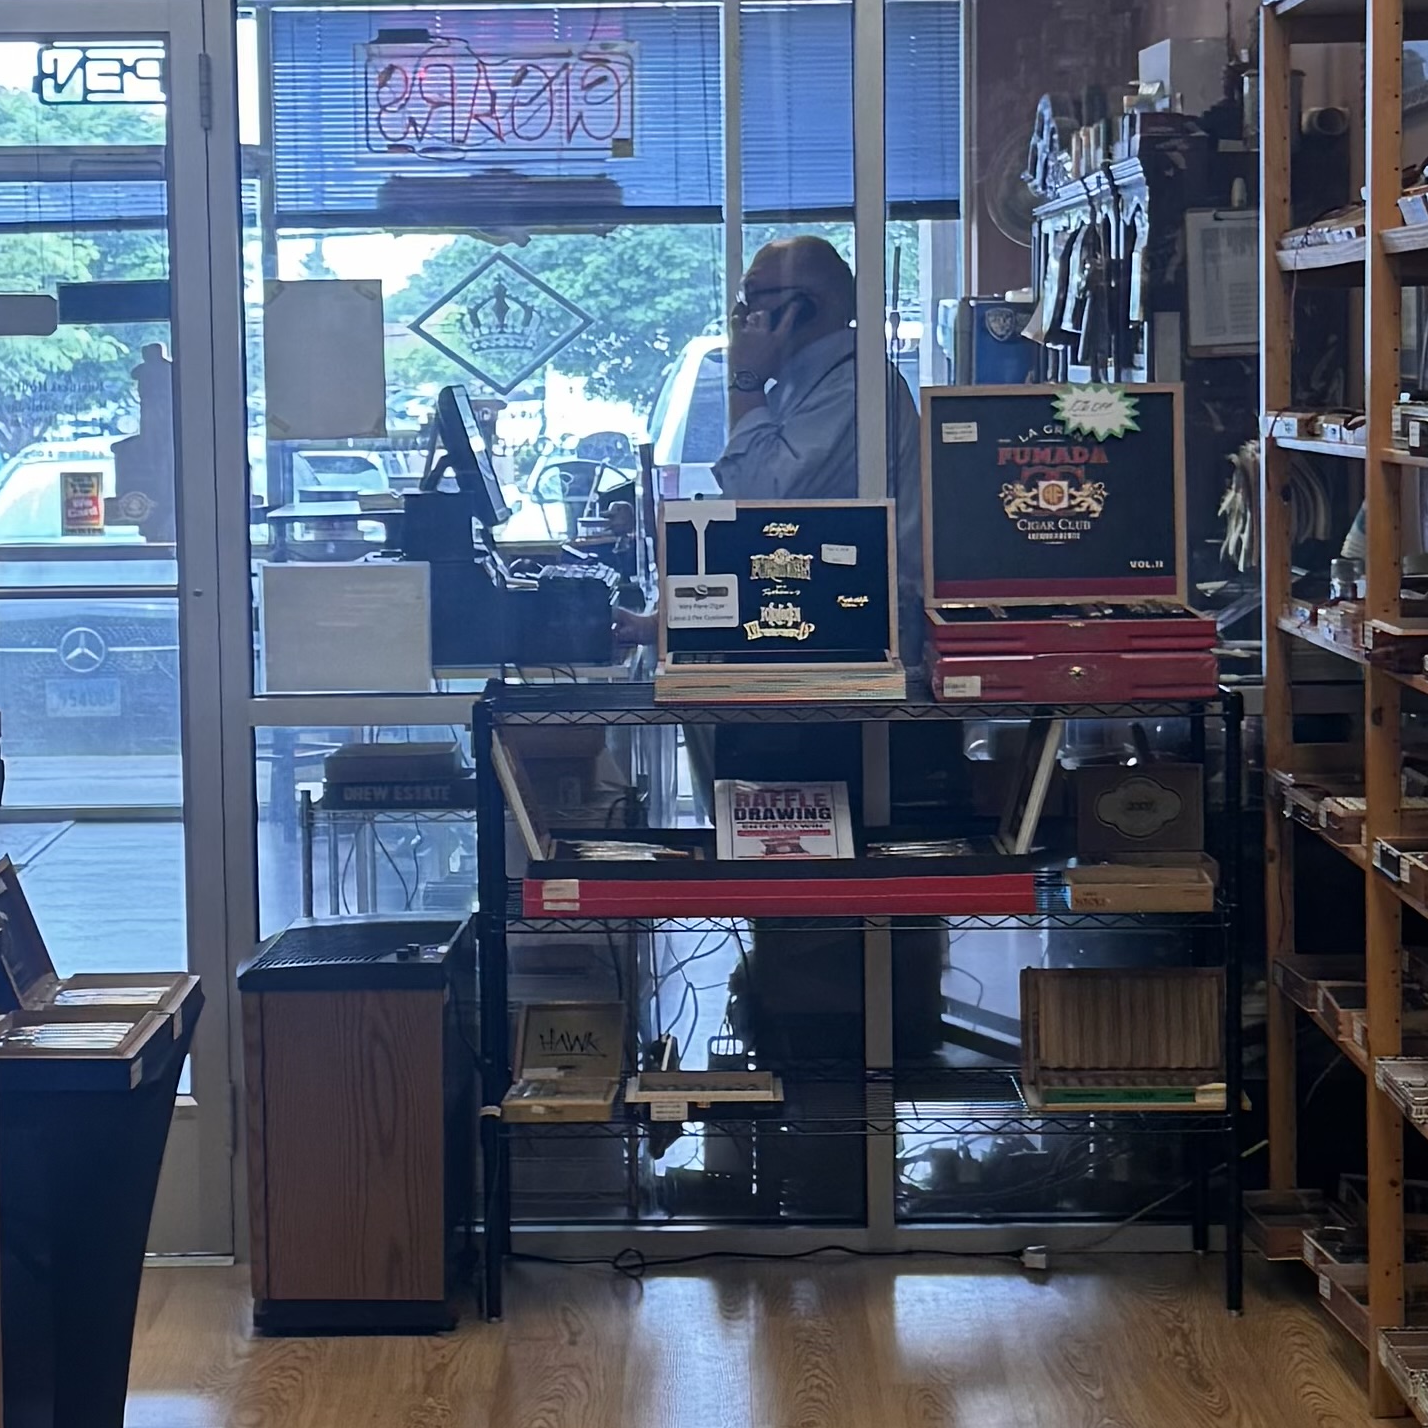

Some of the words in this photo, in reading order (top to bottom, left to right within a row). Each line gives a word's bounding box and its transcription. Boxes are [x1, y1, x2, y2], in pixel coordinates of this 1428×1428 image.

[996, 447, 1109, 466] FUMADA
[735, 793, 827, 807] RAFFLE
[734, 808, 831, 820] DRAWING
[539, 1028, 601, 1052] HAWK
